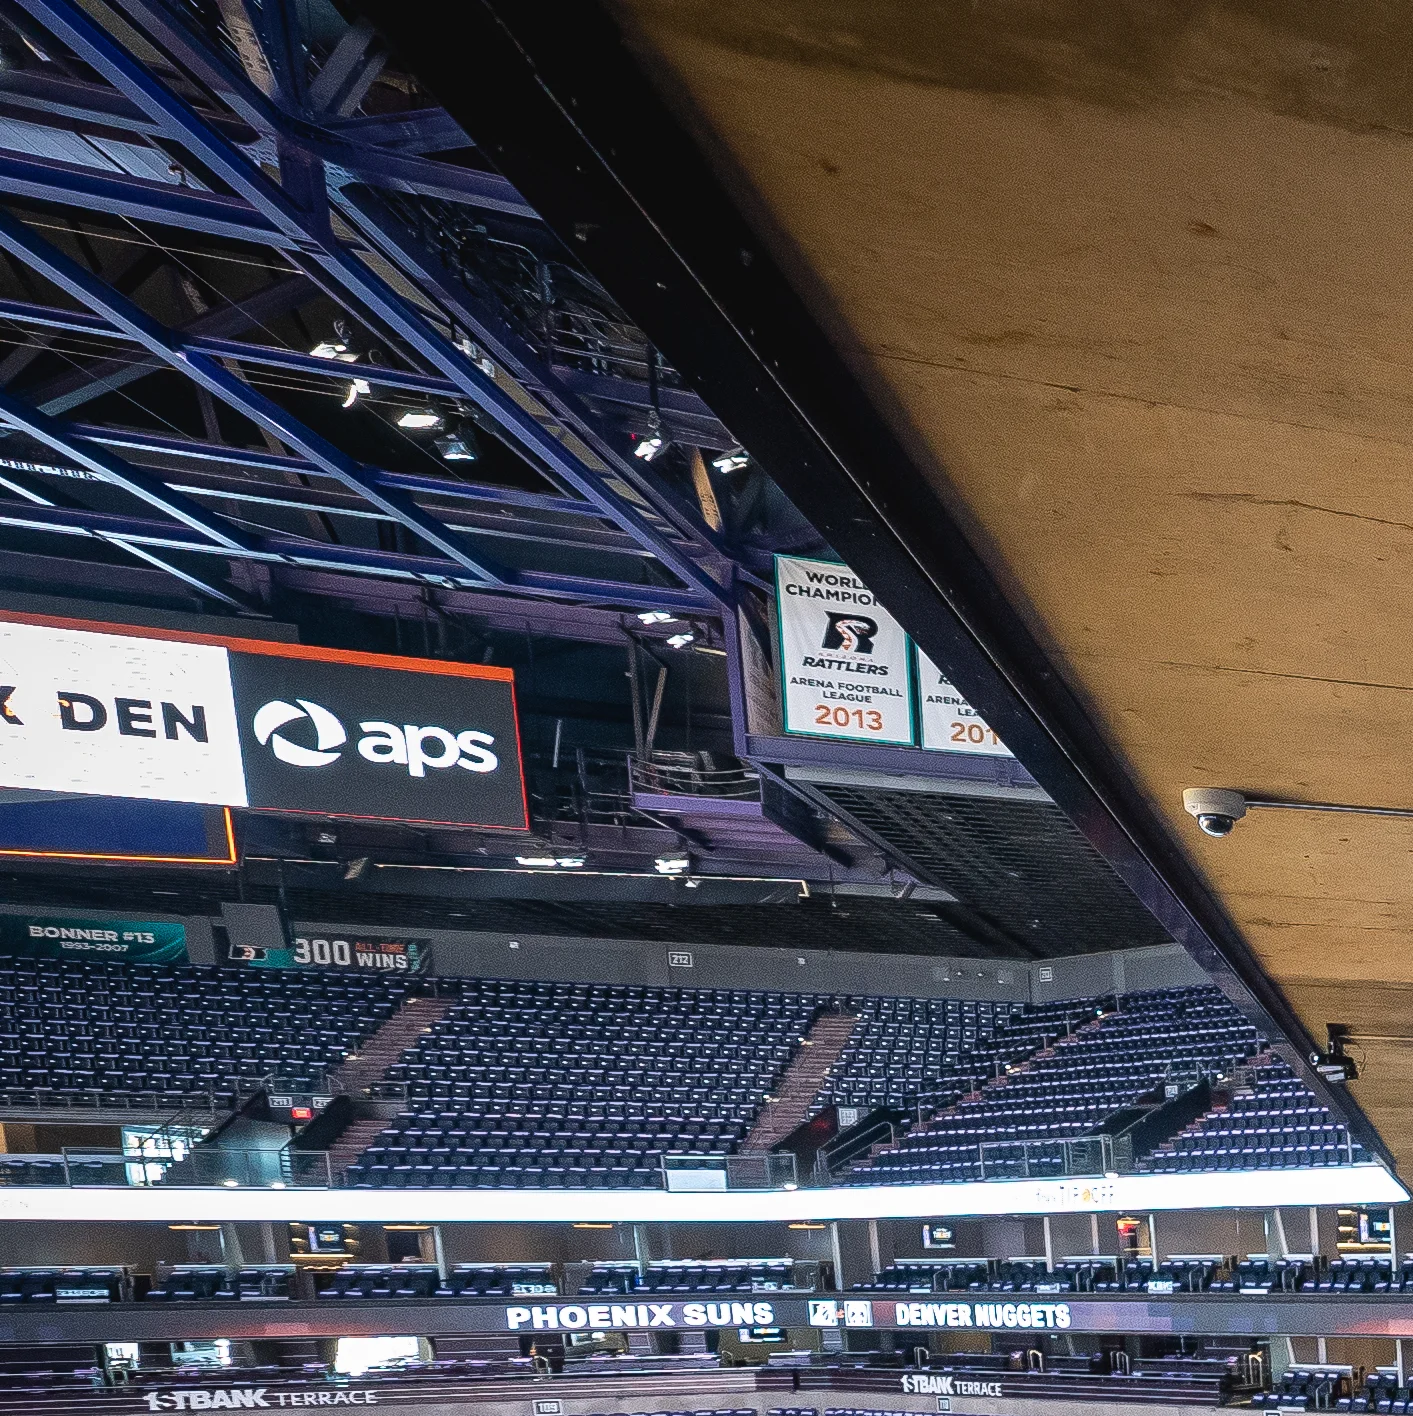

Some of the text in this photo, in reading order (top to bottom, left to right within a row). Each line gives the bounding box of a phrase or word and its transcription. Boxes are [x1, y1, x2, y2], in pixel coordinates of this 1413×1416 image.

[802, 656, 889, 676] RATTLERS
[790, 677, 903, 698] ARENA FOOTBALL
[822, 691, 872, 704] LEAGUE
[57, 691, 209, 743] DEN
[814, 704, 883, 731] 2013
[356, 717, 499, 778] aps
[28, 925, 155, 944] BONNER #13
[293, 938, 351, 965] 300
[356, 952, 408, 969] WINS
[506, 1301, 775, 1330] PHOENIX SUNS
[895, 1302, 1071, 1328] DENVER NUGGETS
[275, 1391, 379, 1407] TERRACE
[955, 1380, 1002, 1397] TERRACE
